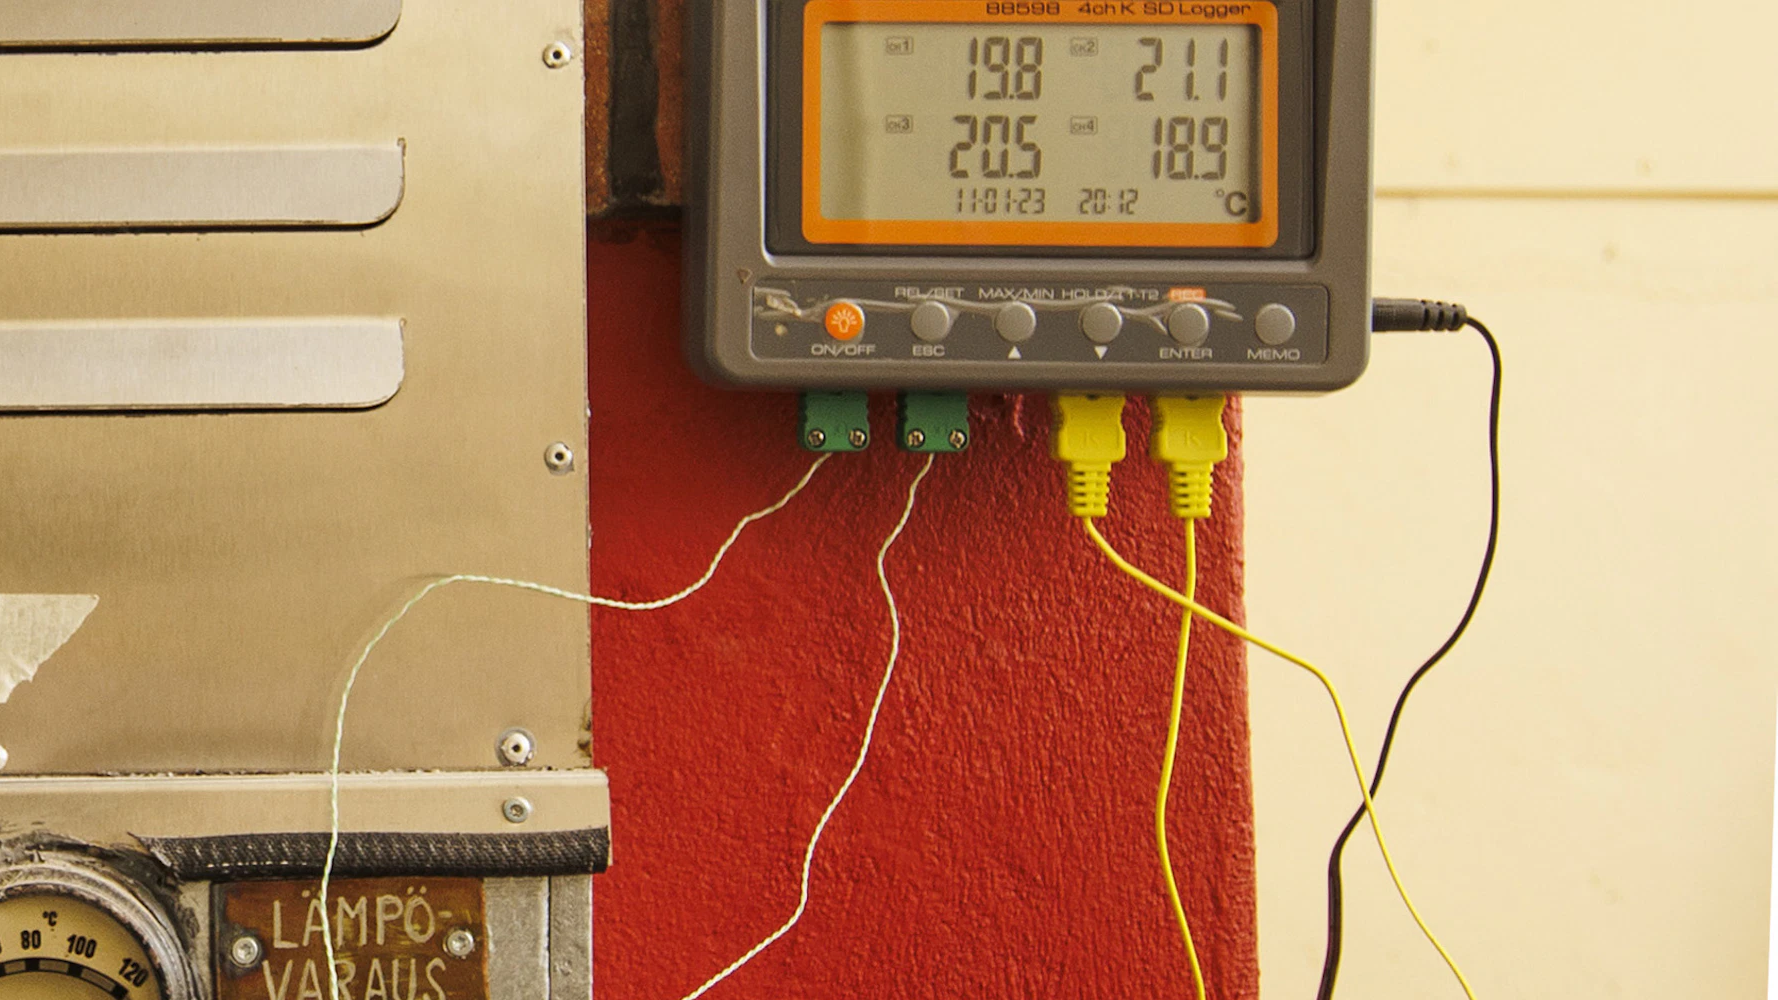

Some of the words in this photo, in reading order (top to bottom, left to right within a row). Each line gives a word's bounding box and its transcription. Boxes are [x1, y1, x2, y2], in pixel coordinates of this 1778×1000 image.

[1078, 0, 1116, 16] 4ch
[1122, 0, 1136, 15] K
[1143, 0, 1174, 15] SD
[1179, 1, 1252, 19] Logger
[967, 36, 1043, 100] 19.8
[1134, 37, 1228, 100] 21.1
[949, 115, 1042, 179] 20.5
[1152, 116, 1228, 180] 18.9
[1079, 188, 1139, 215] 20:12
[1215, 188, 1248, 217] °C
[978, 287, 1054, 299] MAX/MIN
[811, 344, 876, 357] ON/OFF
[912, 345, 945, 357] ESC
[1159, 347, 1213, 359] ENTER
[1247, 348, 1301, 361] MEMO
[42, 910, 58, 927] °C
[20, 930, 42, 950] 80
[67, 934, 98, 959] 100
[118, 956, 151, 988] 120
